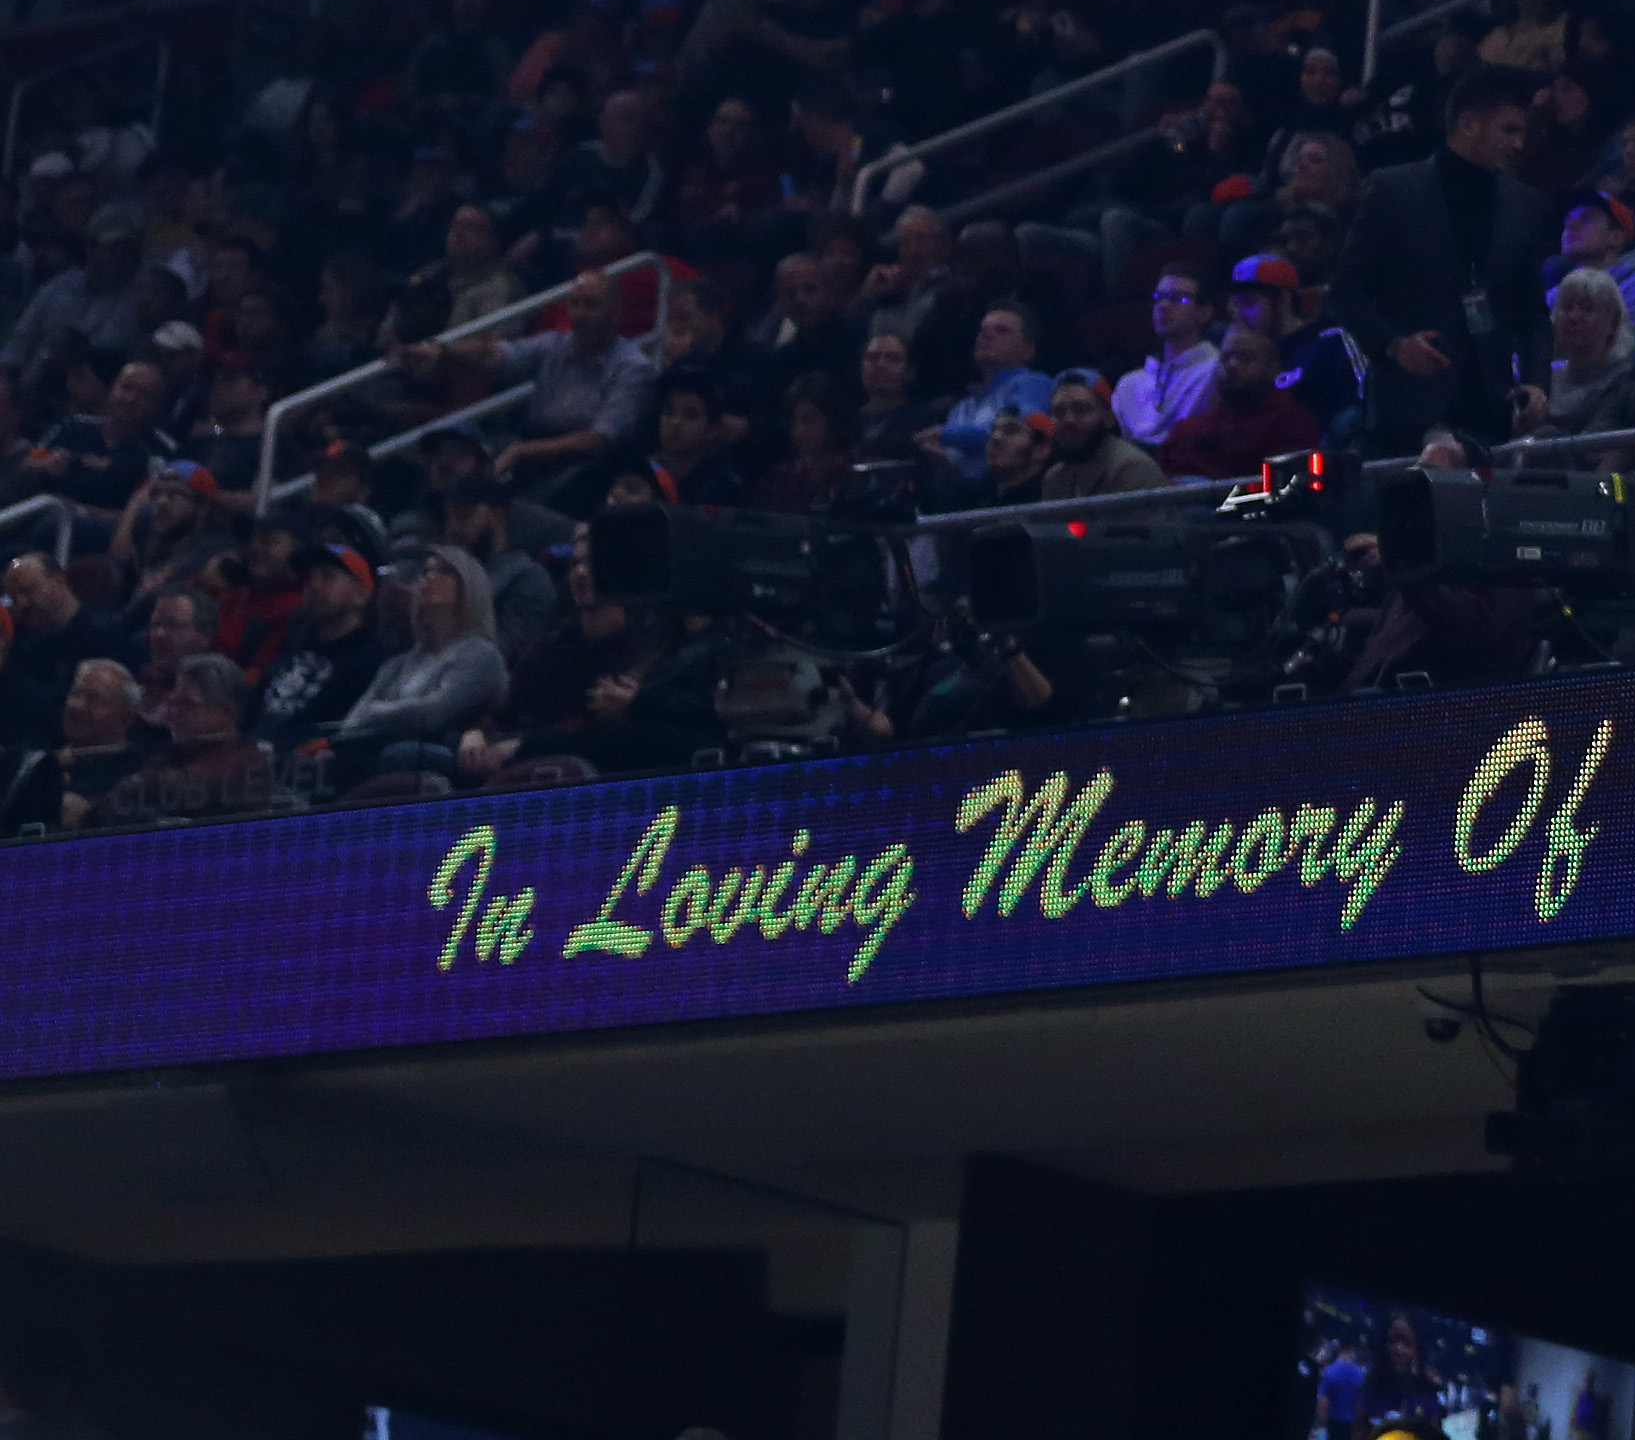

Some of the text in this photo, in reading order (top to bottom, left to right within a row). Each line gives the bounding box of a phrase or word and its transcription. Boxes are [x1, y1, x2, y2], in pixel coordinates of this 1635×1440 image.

[425, 824, 535, 972] In
[561, 804, 918, 985] Loving
[953, 766, 1405, 935] Memory
[1452, 713, 1616, 924] Of
